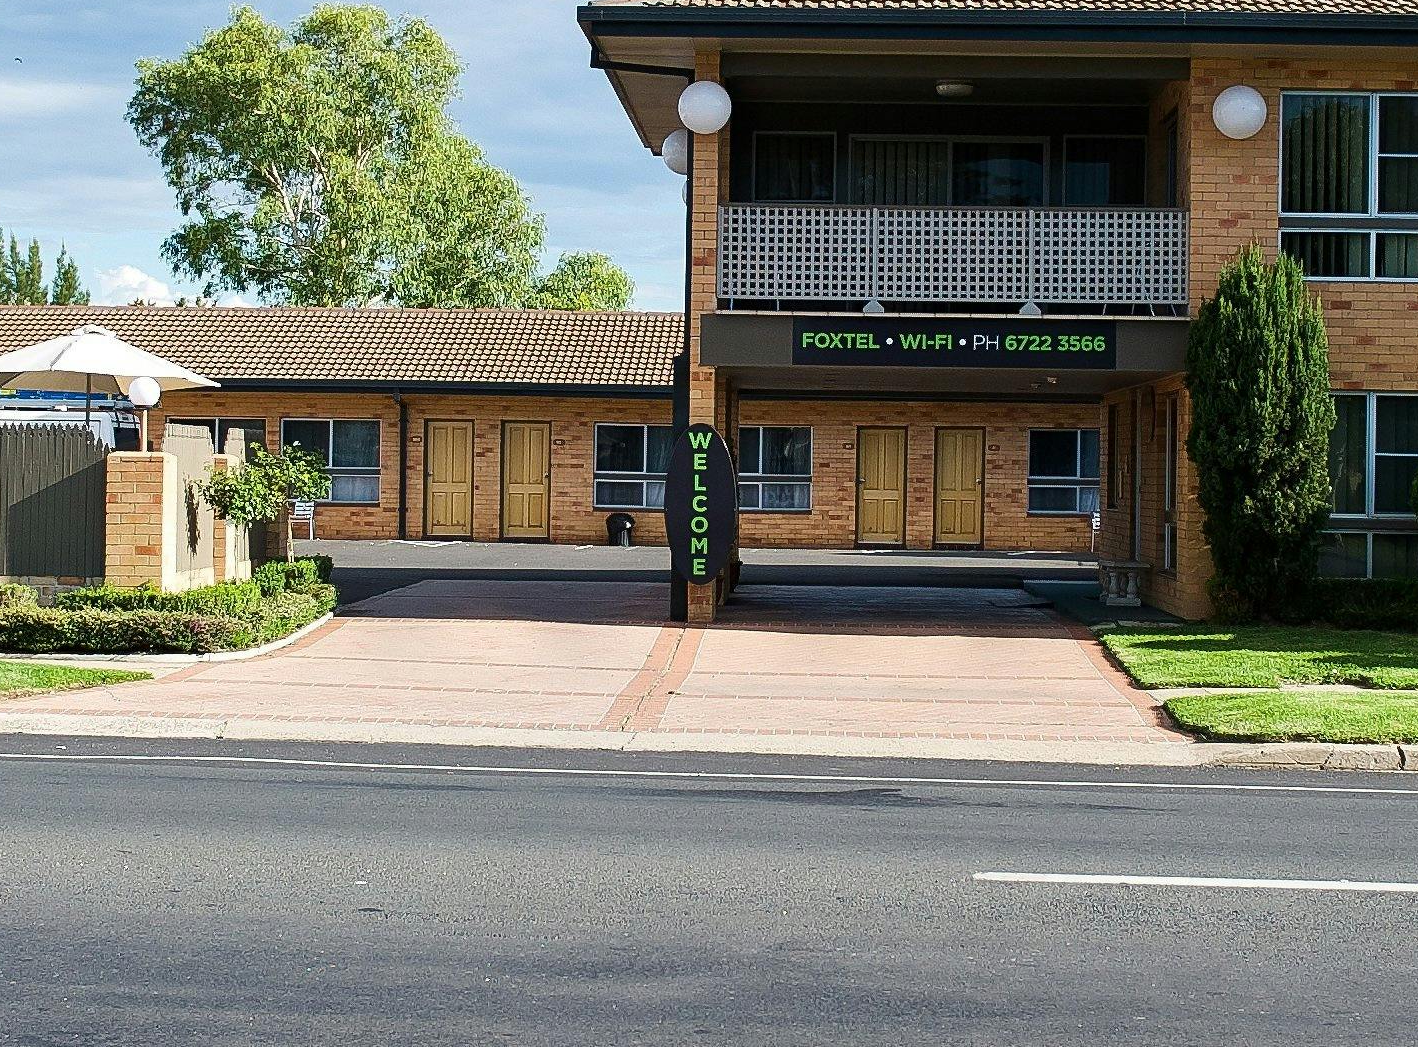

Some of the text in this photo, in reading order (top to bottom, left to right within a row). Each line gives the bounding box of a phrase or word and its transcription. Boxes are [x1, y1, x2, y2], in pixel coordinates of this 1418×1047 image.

[802, 332, 1106, 352] FOXTEL WI-FI PH 6722 3566
[688, 432, 713, 576] WELCOME
